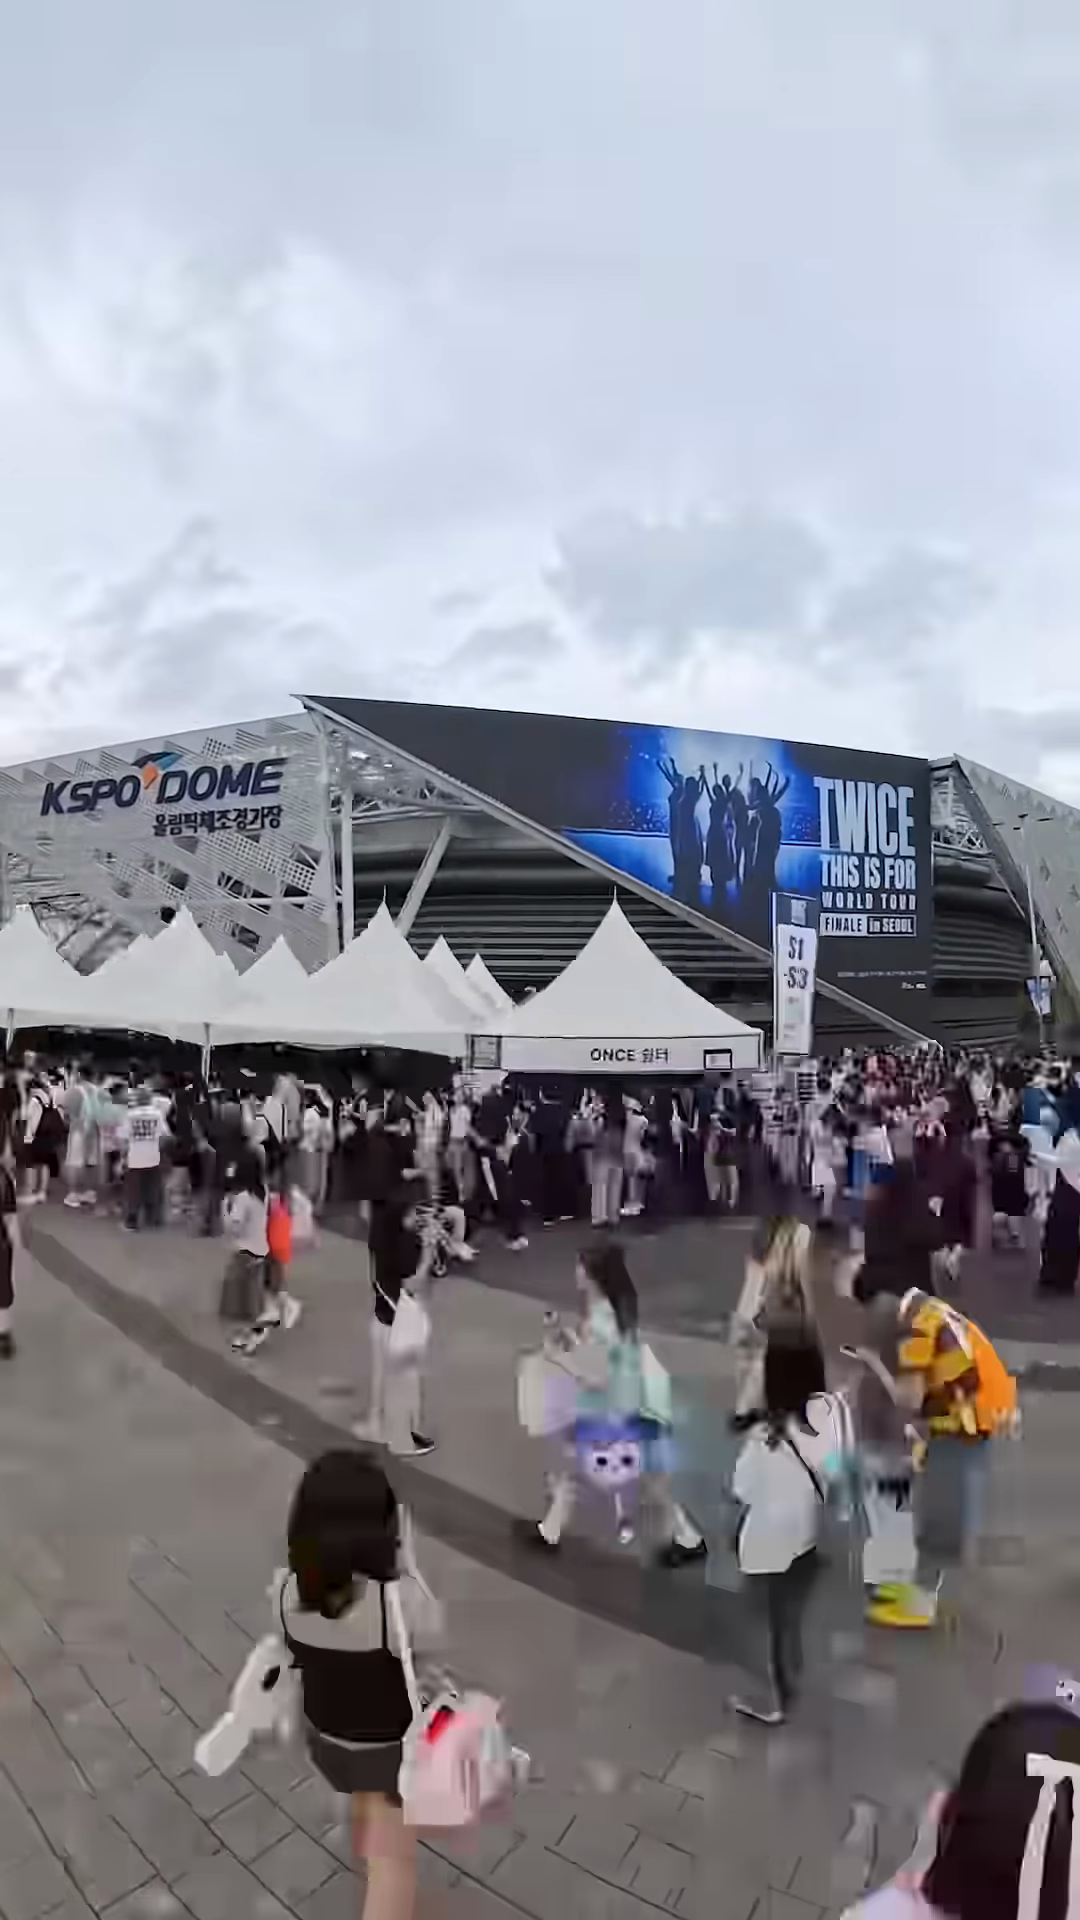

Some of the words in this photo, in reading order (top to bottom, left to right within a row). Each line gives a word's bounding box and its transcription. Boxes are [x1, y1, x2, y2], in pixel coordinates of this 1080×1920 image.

[41, 775, 141, 816] KSPO
[156, 758, 288, 803] DOME
[813, 777, 915, 856] TWICE
[820, 856, 861, 888] THIS
[864, 858, 881, 889] IS
[885, 859, 916, 889] FOR
[822, 892, 873, 909] WORLD
[825, 917, 862, 932] FINALE
[869, 918, 880, 931] in
[882, 918, 913, 932] SEOUL
[591, 1048, 635, 1061] ONCE
